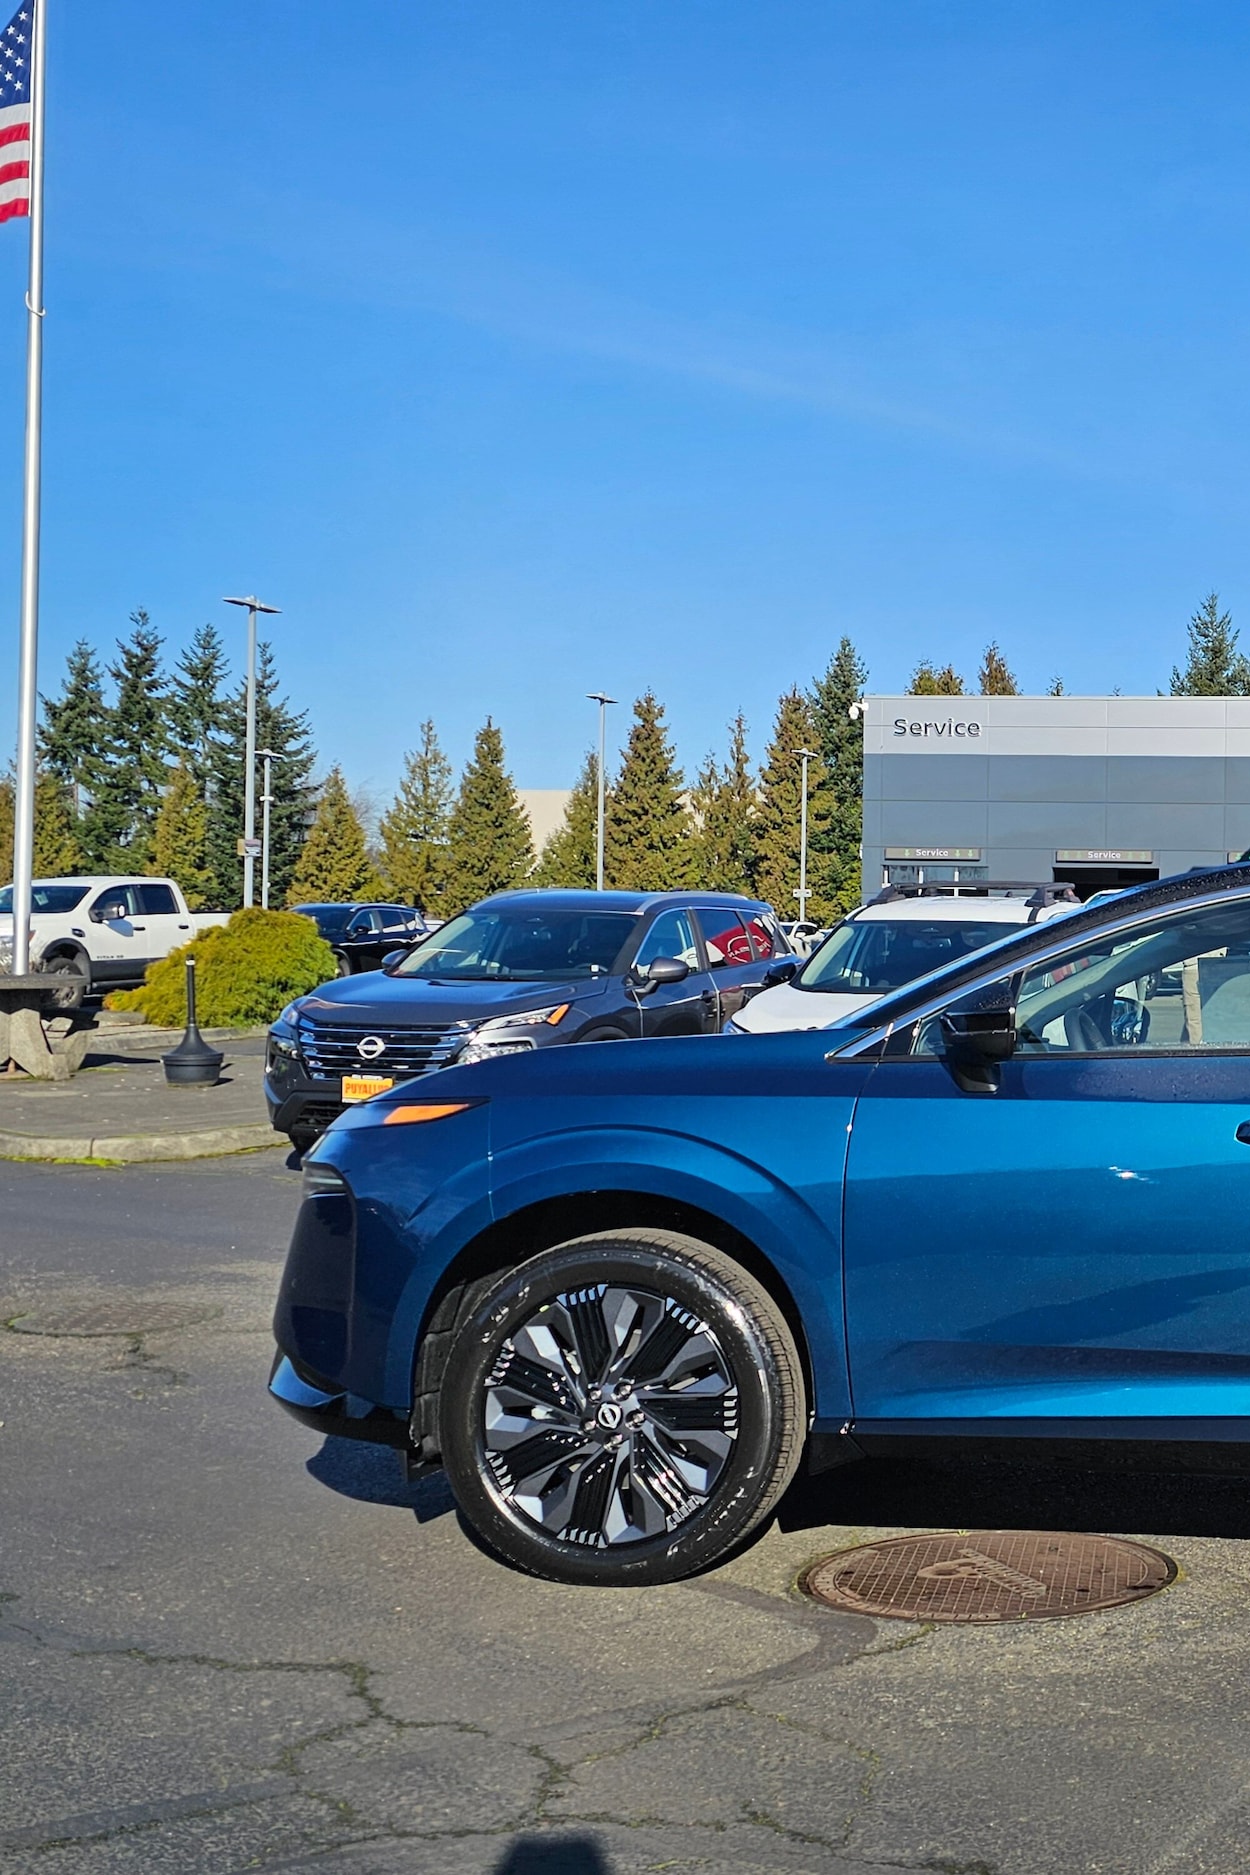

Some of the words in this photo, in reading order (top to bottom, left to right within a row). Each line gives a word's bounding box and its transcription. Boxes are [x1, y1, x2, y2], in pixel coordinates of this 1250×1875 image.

[893, 717, 981, 738] Service
[915, 848, 949, 857] Service
[1087, 850, 1121, 859] Service
